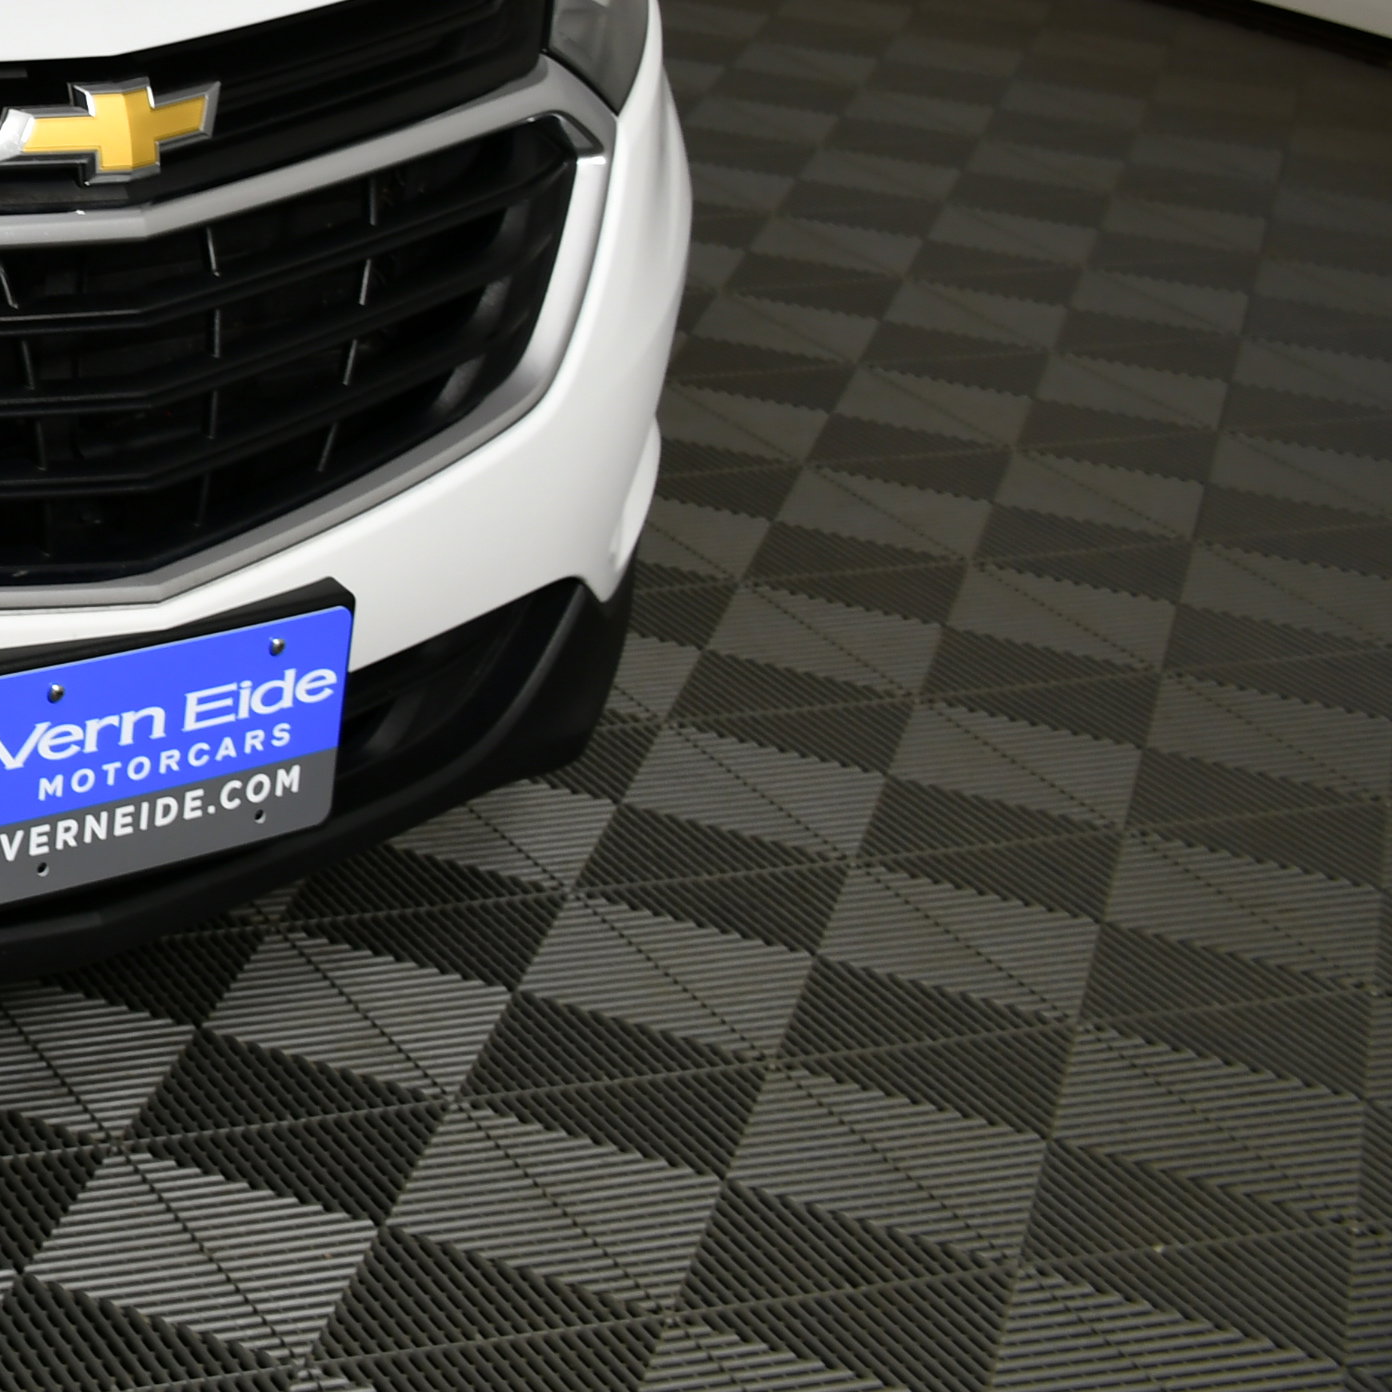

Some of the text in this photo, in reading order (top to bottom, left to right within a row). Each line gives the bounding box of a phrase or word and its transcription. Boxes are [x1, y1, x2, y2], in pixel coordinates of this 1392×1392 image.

[182, 668, 337, 732] Eide
[38, 723, 292, 800] MOTORCARS
[0, 765, 302, 862] VERNEIDE.COM
